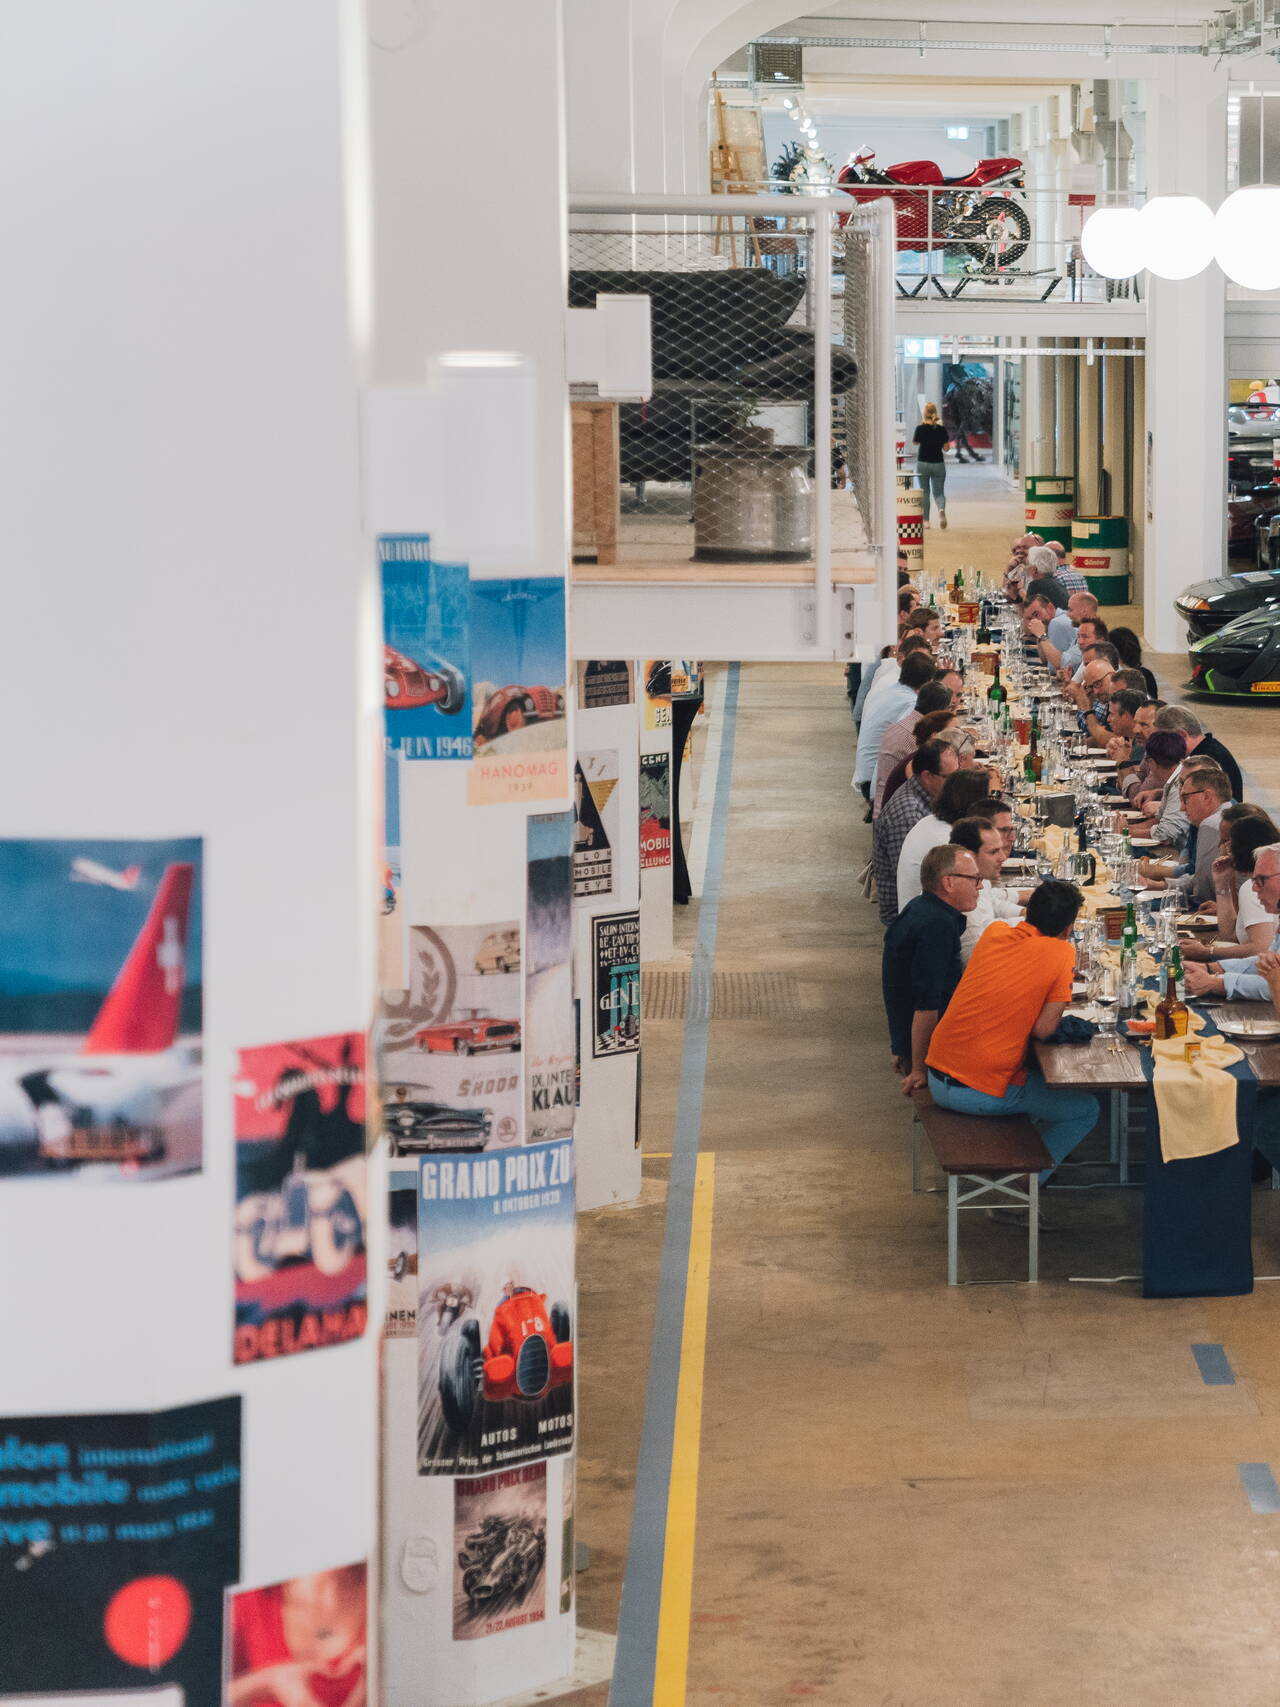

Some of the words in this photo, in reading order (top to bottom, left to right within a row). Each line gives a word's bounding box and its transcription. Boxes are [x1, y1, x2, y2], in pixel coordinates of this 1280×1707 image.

[480, 761, 559, 780] HANOMAG
[532, 1085, 573, 1112] KLAU
[422, 1158, 500, 1200] GRAND
[505, 1152, 546, 1194] PRIX
[480, 1427, 518, 1447] AUTOS
[538, 1414, 574, 1434] MOTOS
